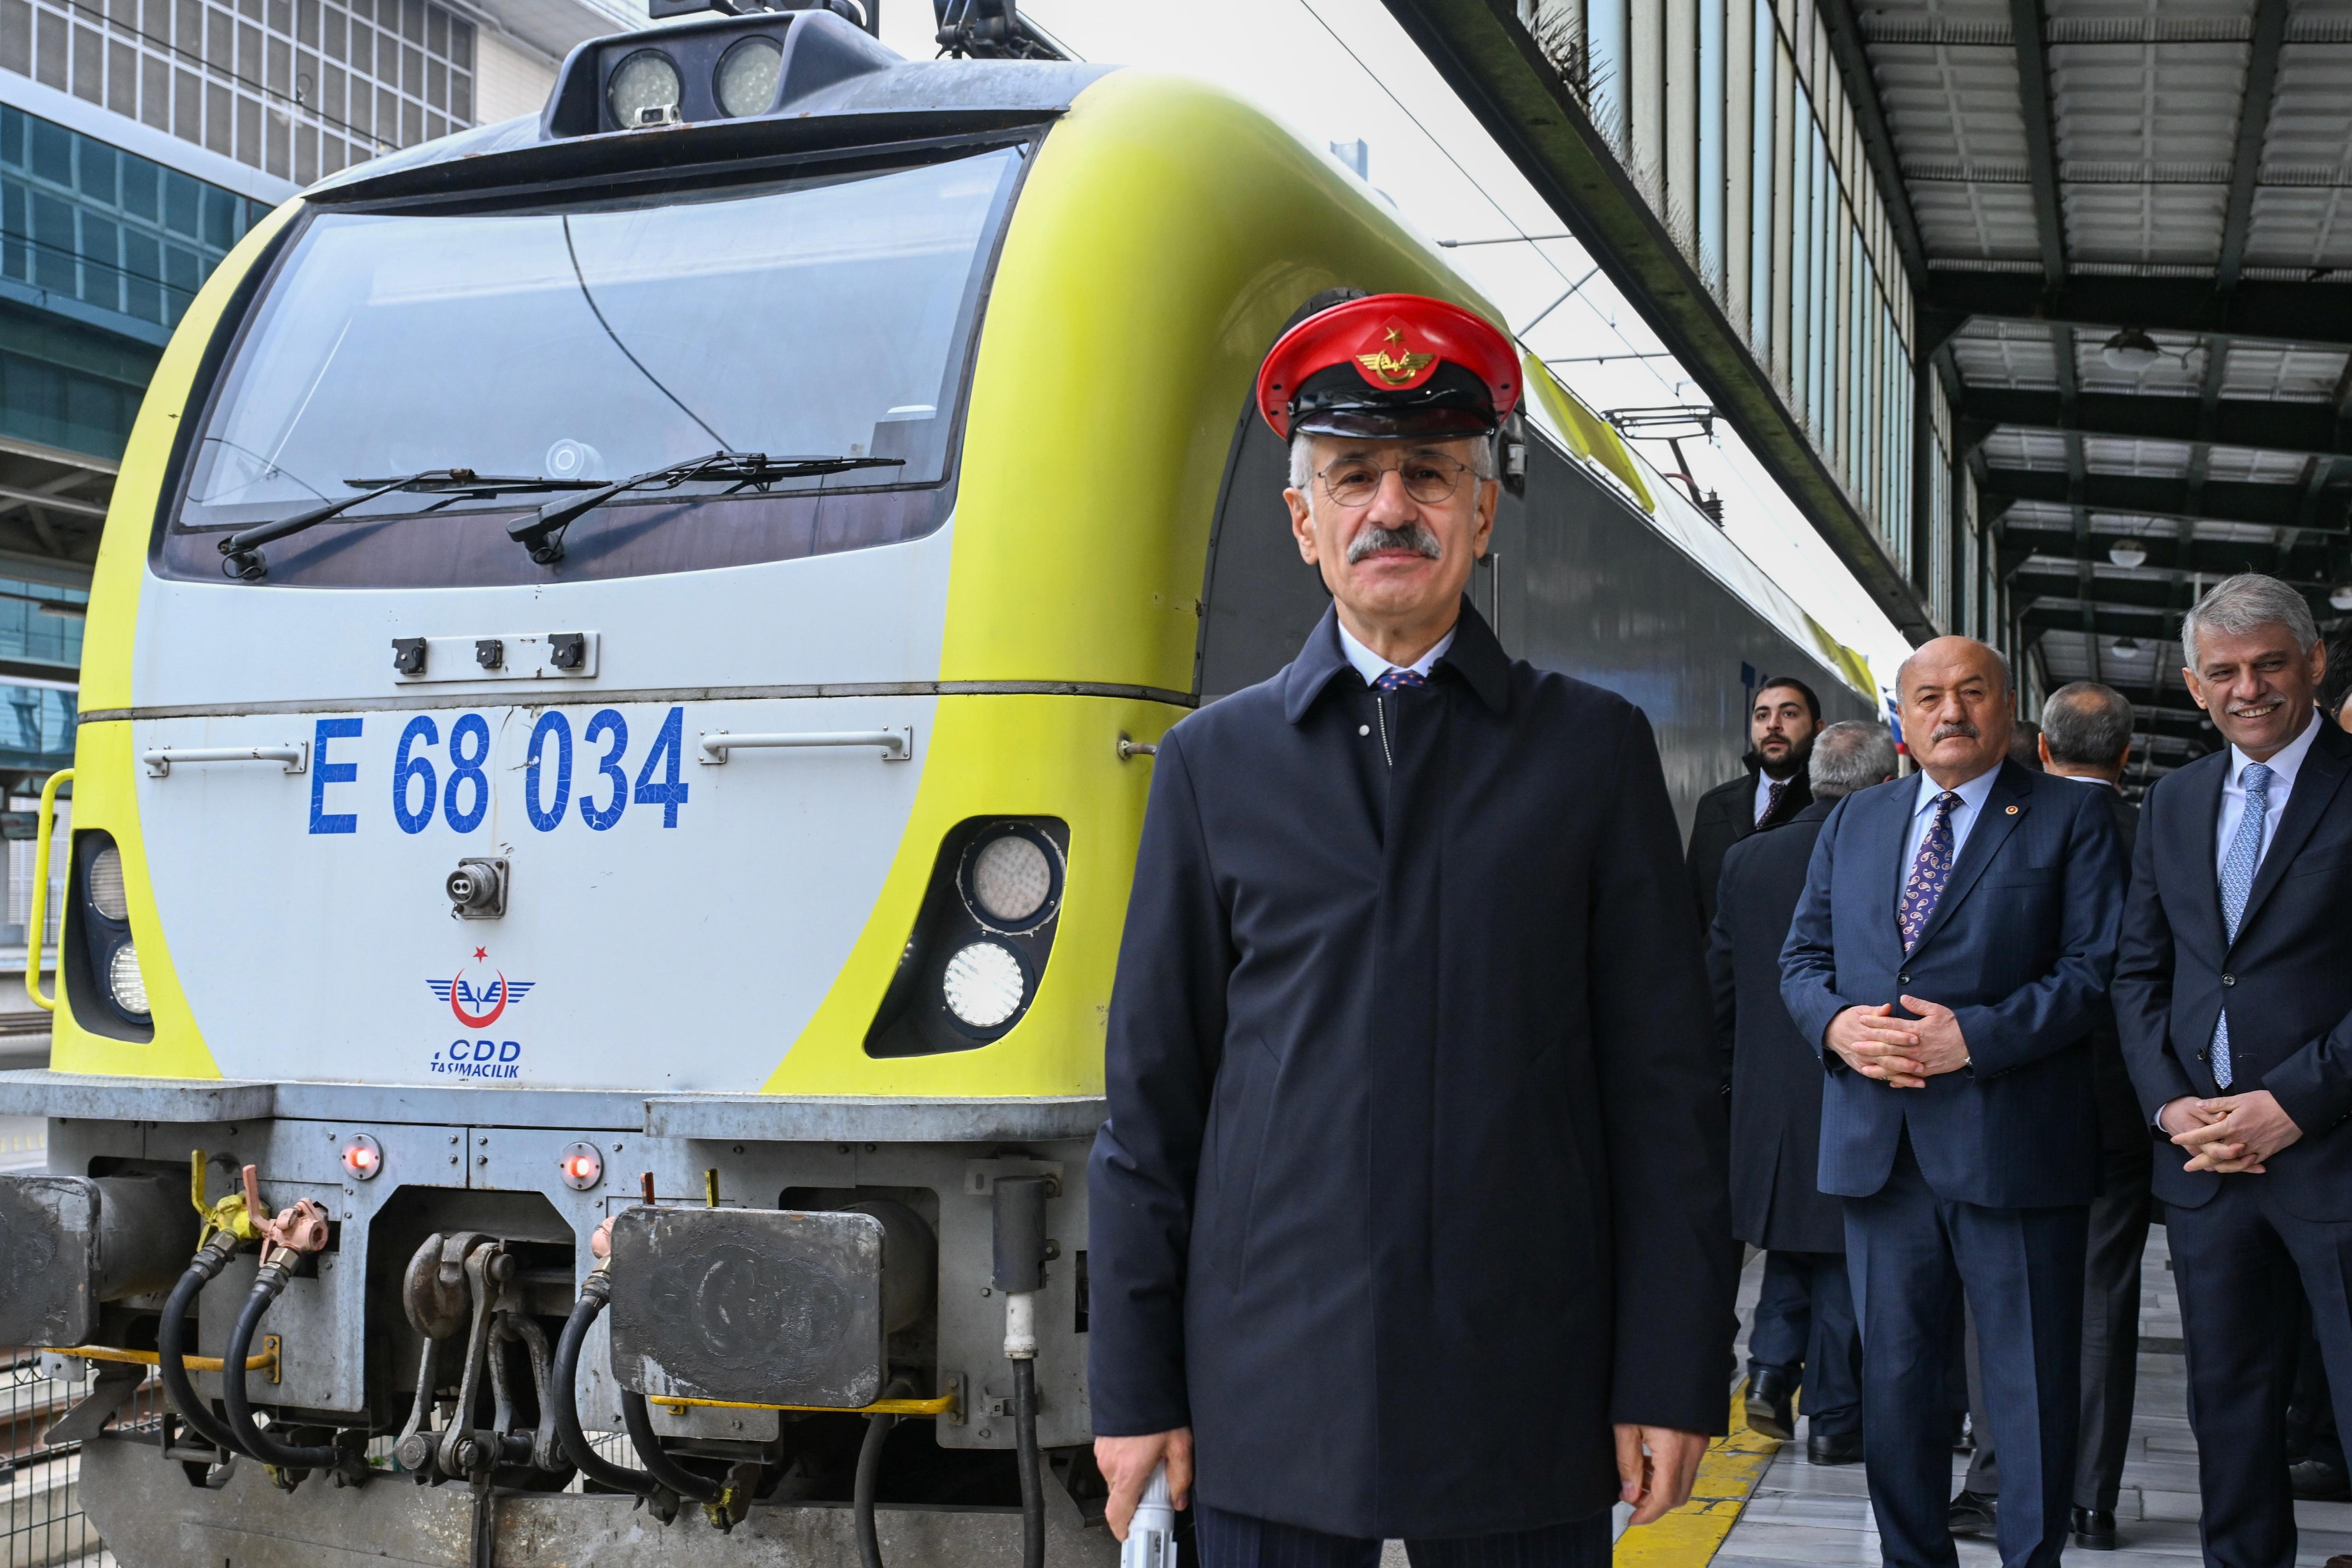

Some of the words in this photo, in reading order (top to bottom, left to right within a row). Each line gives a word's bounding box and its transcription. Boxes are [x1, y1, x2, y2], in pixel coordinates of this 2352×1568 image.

[309, 717, 363, 835] E
[393, 713, 490, 835] 68
[525, 707, 689, 832] 034
[434, 1039, 521, 1062] CDD
